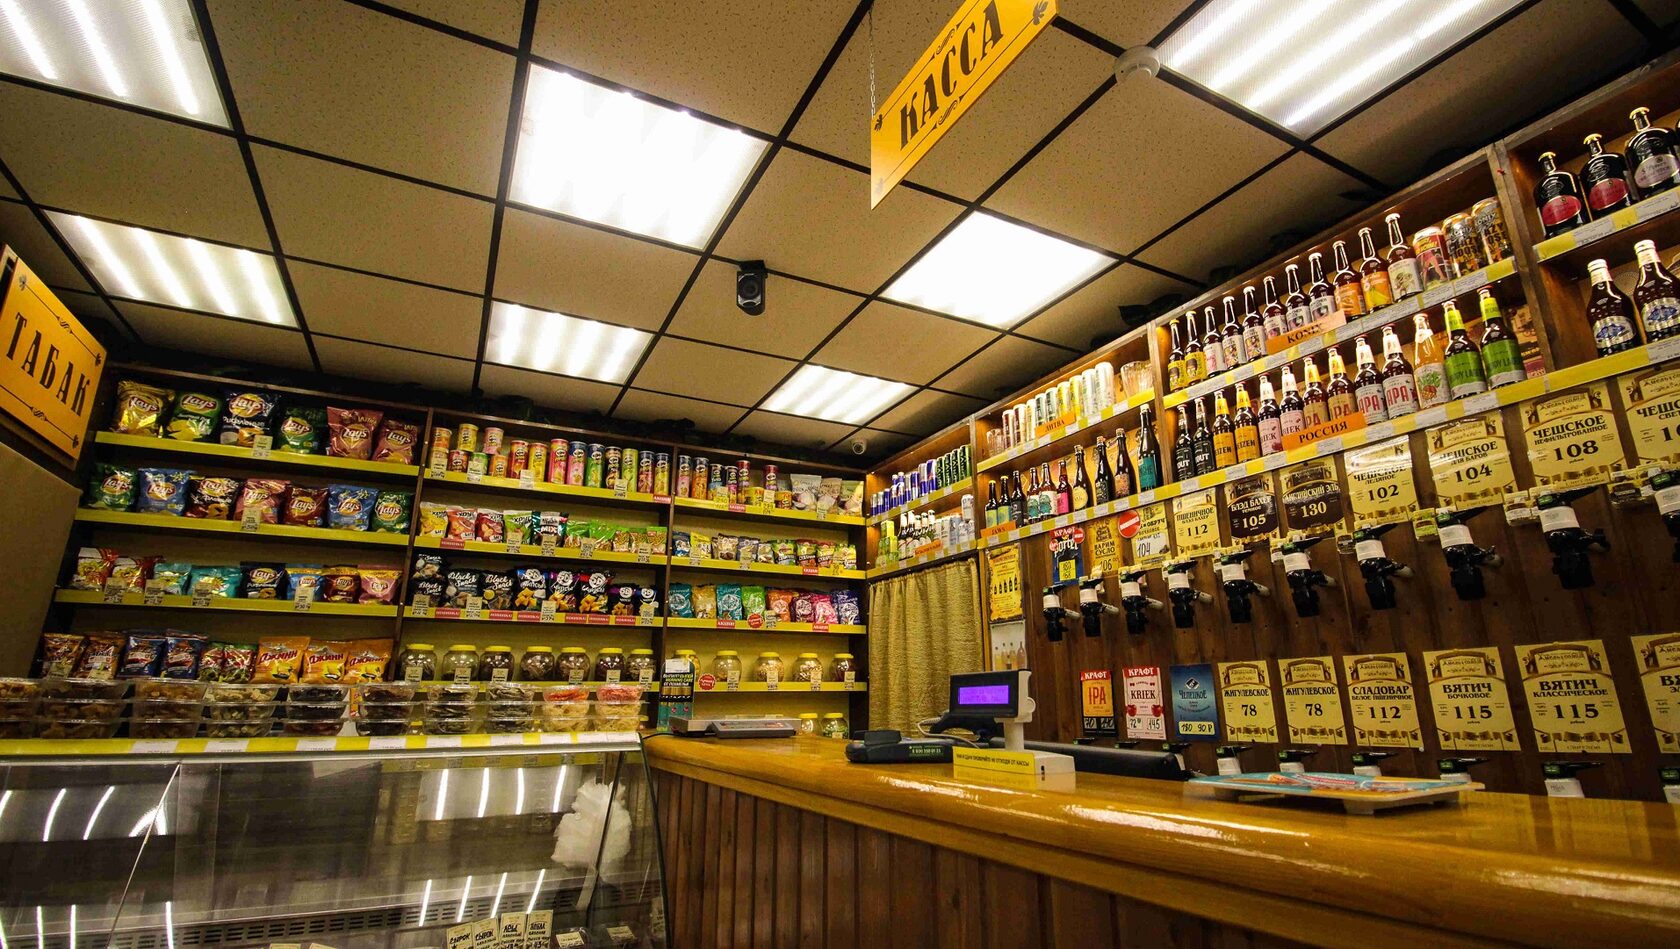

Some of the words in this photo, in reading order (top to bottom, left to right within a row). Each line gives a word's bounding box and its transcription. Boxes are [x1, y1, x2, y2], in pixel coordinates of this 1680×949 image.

[900, 0, 1004, 150] КАССА
[6, 312, 91, 418] ТАБАК
[1299, 422, 1348, 443] РОССИЯ
[1533, 414, 1606, 439] ЧЕШСКОЕ
[1534, 423, 1608, 445] НЕФИЛЬТРОВАННОЕ
[1554, 440, 1599, 462] 108
[1455, 463, 1492, 483] 104
[1368, 484, 1400, 502] 102
[1301, 501, 1327, 518] 130
[1242, 513, 1266, 529] 105
[1187, 524, 1208, 537] 112
[1094, 541, 1115, 551] ВАРИМ
[447, 571, 471, 580] Black
[455, 575, 477, 587] Snack
[485, 574, 507, 583] Black
[492, 579, 513, 590] Snack
[1084, 671, 1107, 680] КРАФТ
[1128, 667, 1154, 677] КРАФТ
[1285, 686, 1337, 696] ЖИГУЛЕВСКОЕ
[1352, 685, 1410, 696] СЛАДОВАР
[1442, 682, 1493, 694] ВЯТИЧ
[1539, 678, 1598, 691] ВЯТИЧ
[1088, 686, 1107, 705] IPA
[1130, 690, 1156, 700] KRIEK
[1223, 688, 1270, 698] ЖИГУЛЕВСКОЕ
[1447, 692, 1491, 700] БОЧКОВОЕ
[1532, 688, 1608, 698] КЛАССИЧЕСКОЕ
[1241, 704, 1258, 717] 78
[1305, 703, 1323, 717] 78
[1369, 705, 1401, 720] 112
[1454, 705, 1493, 720] 115
[1554, 703, 1599, 719] 115
